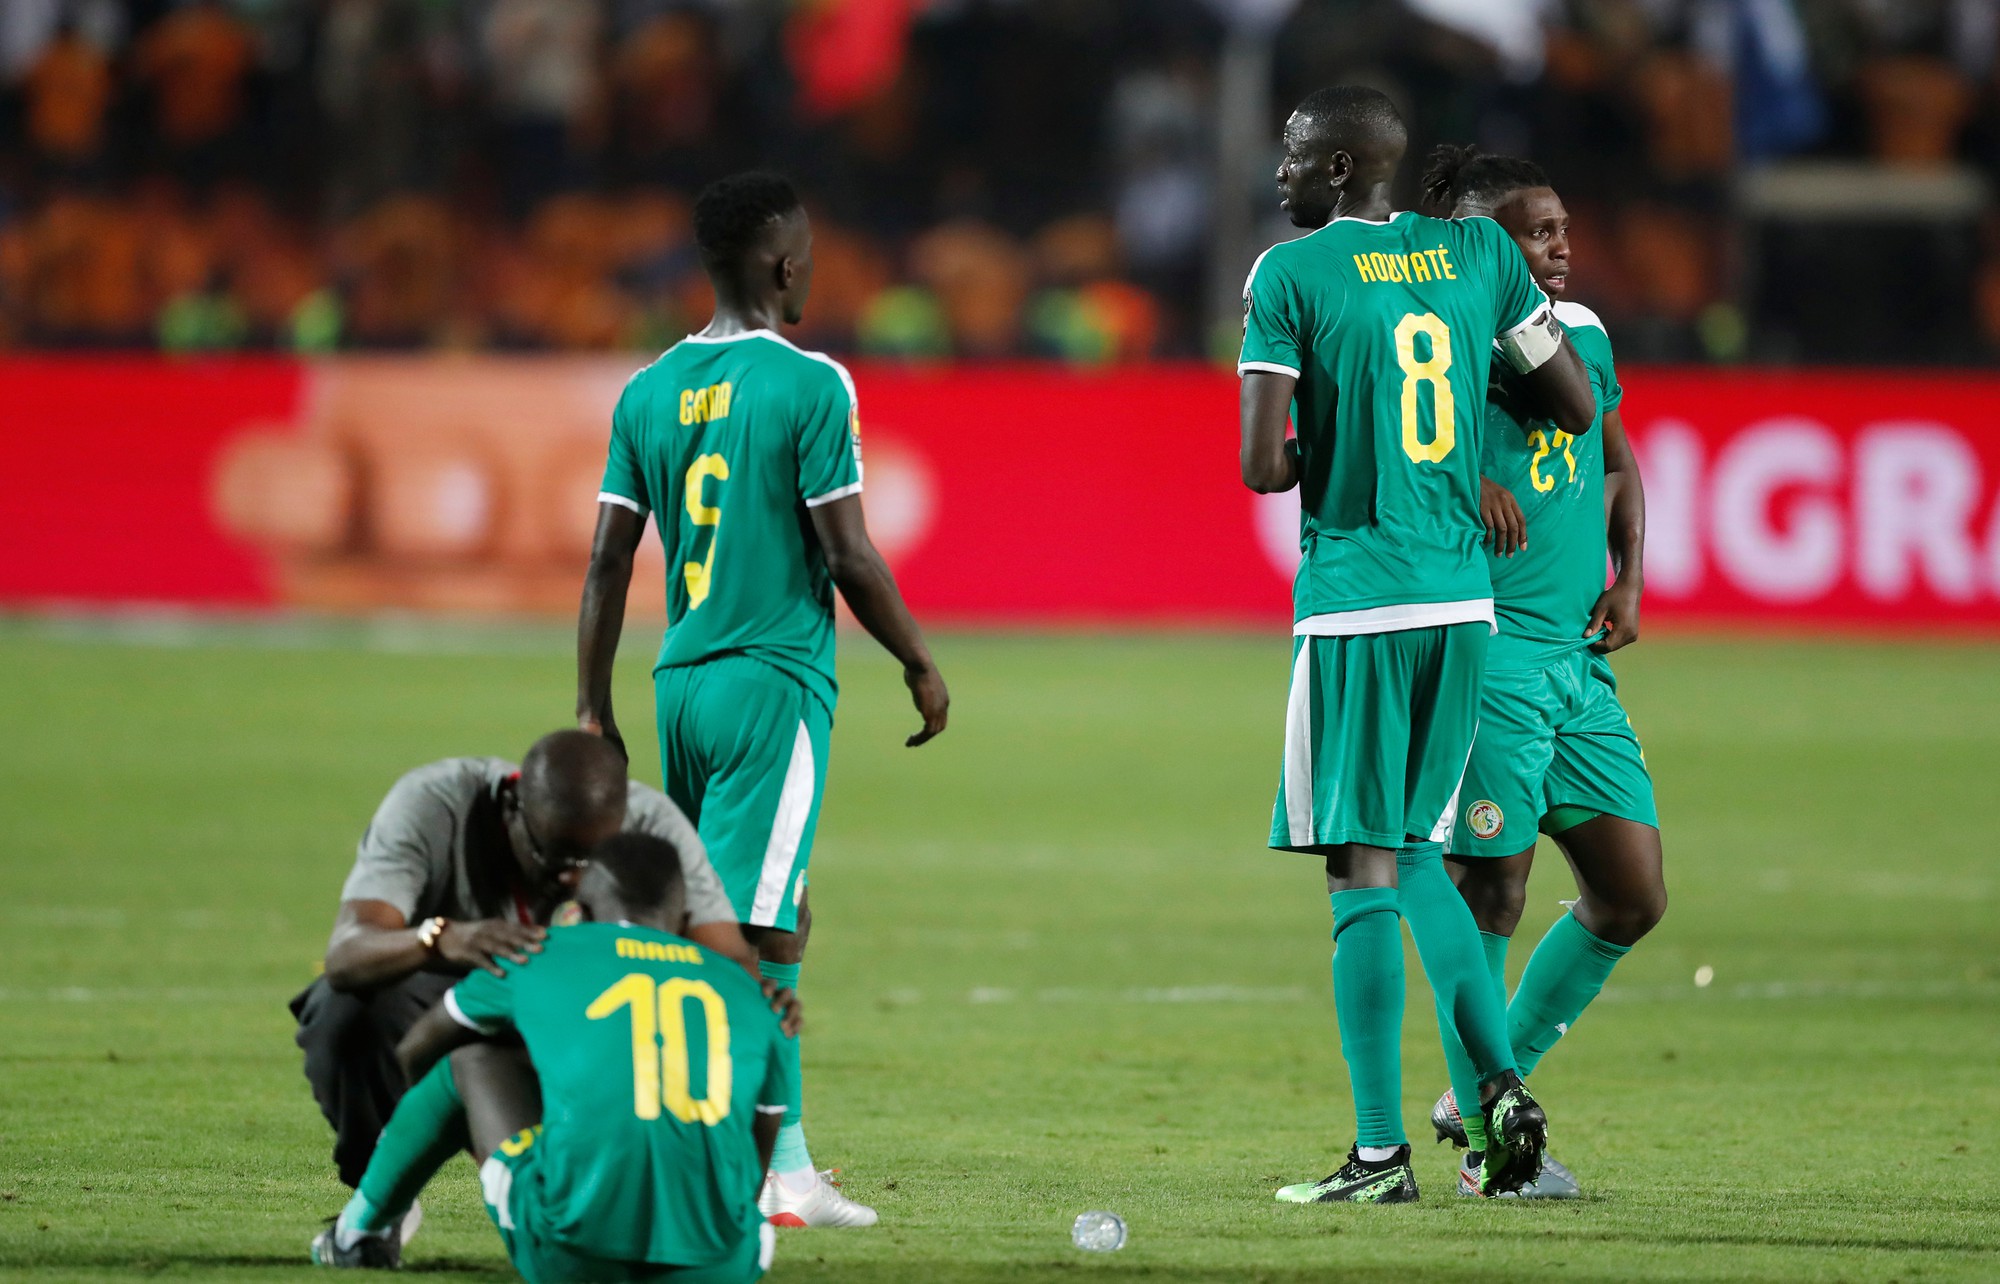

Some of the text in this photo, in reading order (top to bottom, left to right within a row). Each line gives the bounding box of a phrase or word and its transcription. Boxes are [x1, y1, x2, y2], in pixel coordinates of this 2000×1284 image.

[1353, 244, 1457, 284] KOUYATÉ
[1393, 312, 1455, 464] 8
[1527, 429, 1576, 493] 27
[684, 452, 730, 611] 5
[585, 973, 733, 1126] 10
